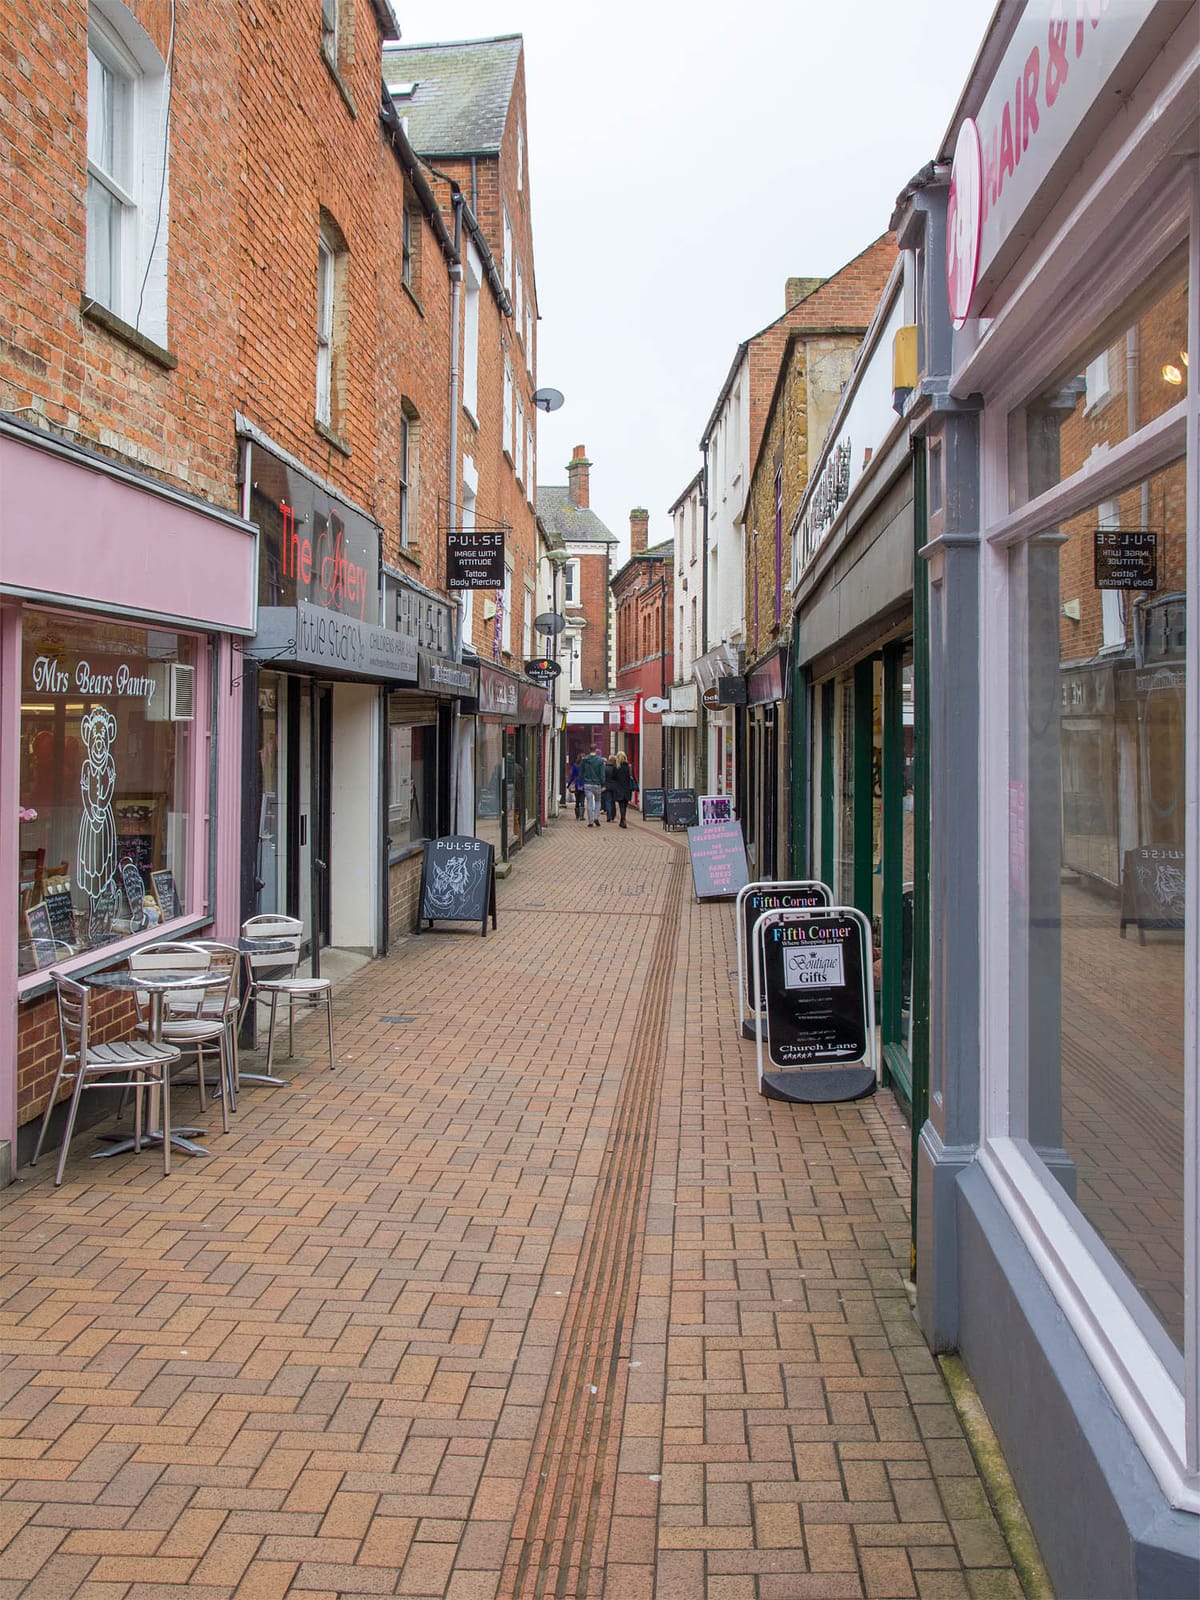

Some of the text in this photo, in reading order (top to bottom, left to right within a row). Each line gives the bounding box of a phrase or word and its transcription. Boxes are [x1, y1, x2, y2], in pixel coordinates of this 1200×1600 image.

[983, 46, 1040, 223] HAIR
[280, 503, 312, 585] The
[450, 578, 501, 587] Body Piercing
[32, 656, 157, 705] Mrs Bears Pantry
[752, 895, 818, 908] Fifth Corner
[773, 926, 851, 941] Fifth Corner
[788, 955, 838, 974] Boutique
[799, 972, 827, 983] Gifts
[779, 1044, 824, 1052] Church
